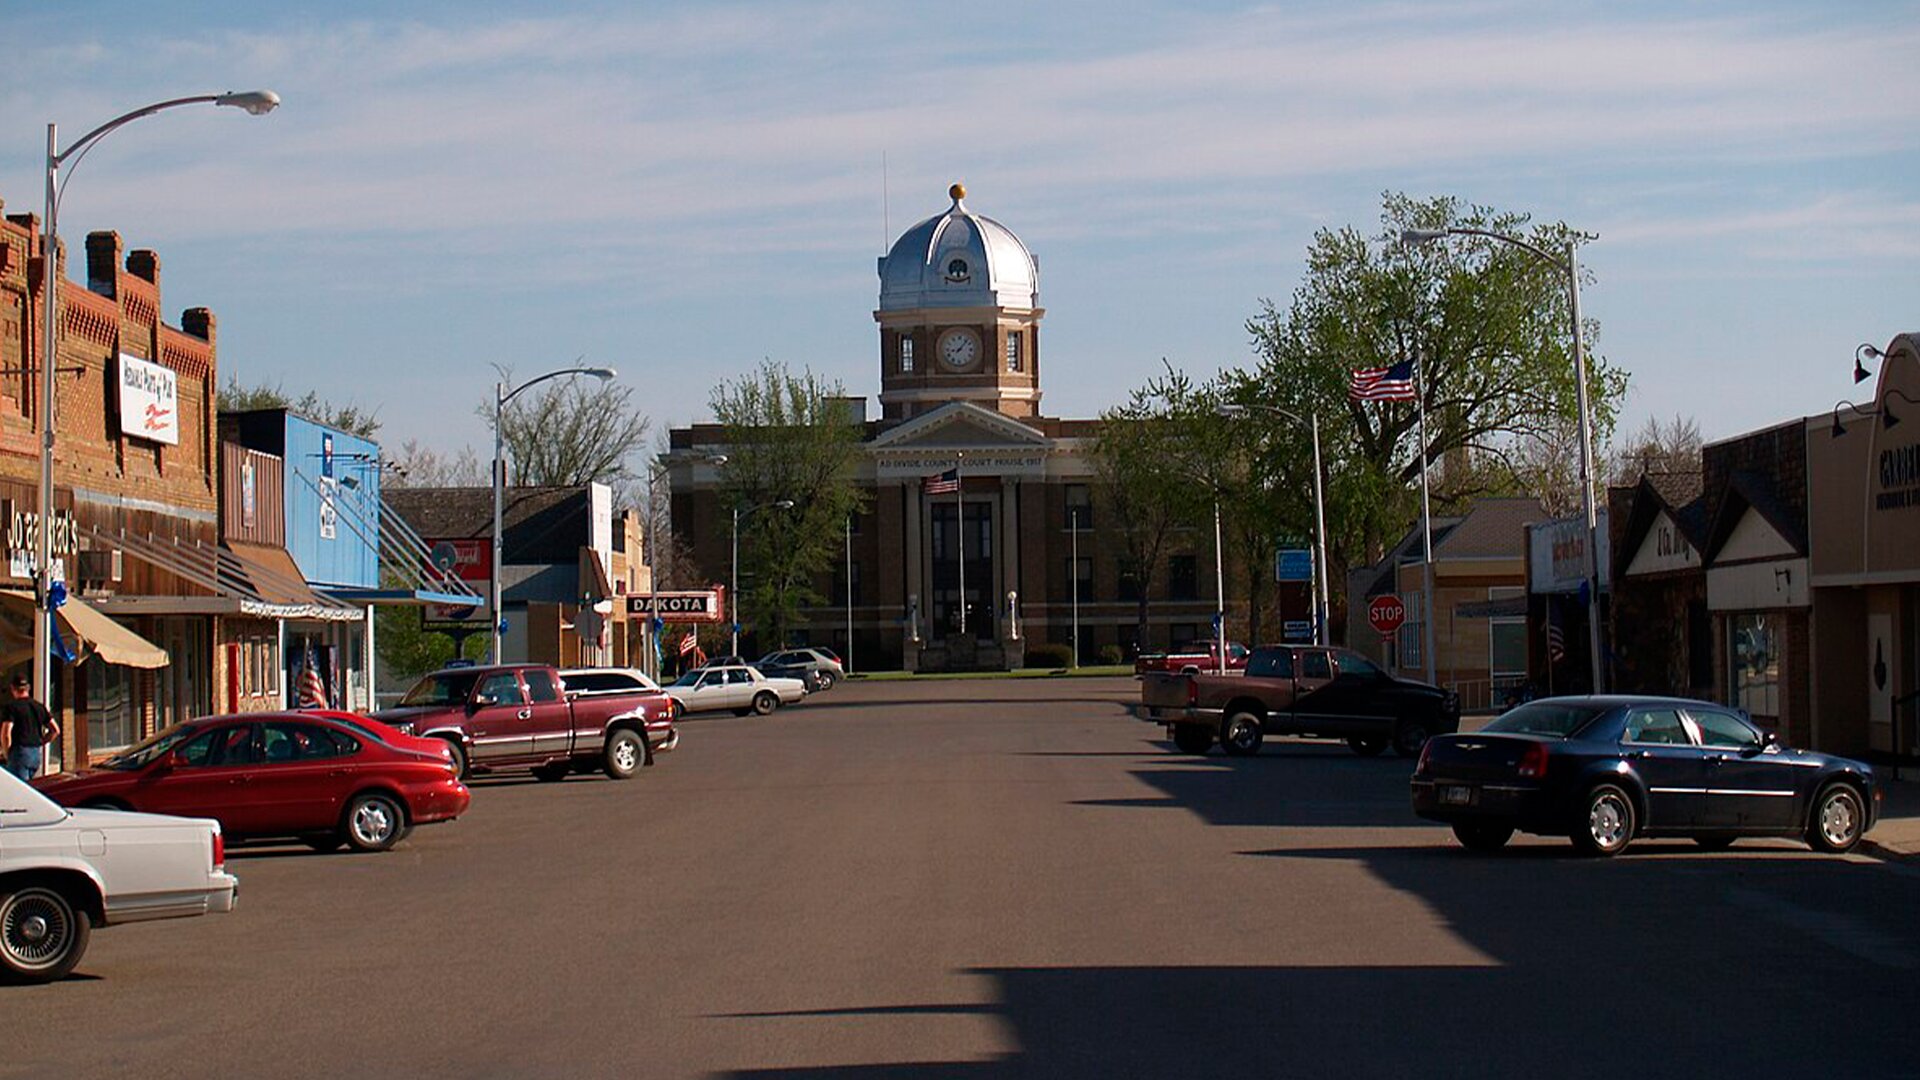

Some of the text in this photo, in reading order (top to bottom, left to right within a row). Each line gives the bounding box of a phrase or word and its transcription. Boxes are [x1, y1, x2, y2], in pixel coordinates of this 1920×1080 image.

[923, 459, 959, 467] COUNTY
[962, 458, 991, 466] COURT
[994, 457, 1024, 466] HOUSE
[633, 597, 702, 611] DAKOTA
[1371, 606, 1402, 622] STOP
